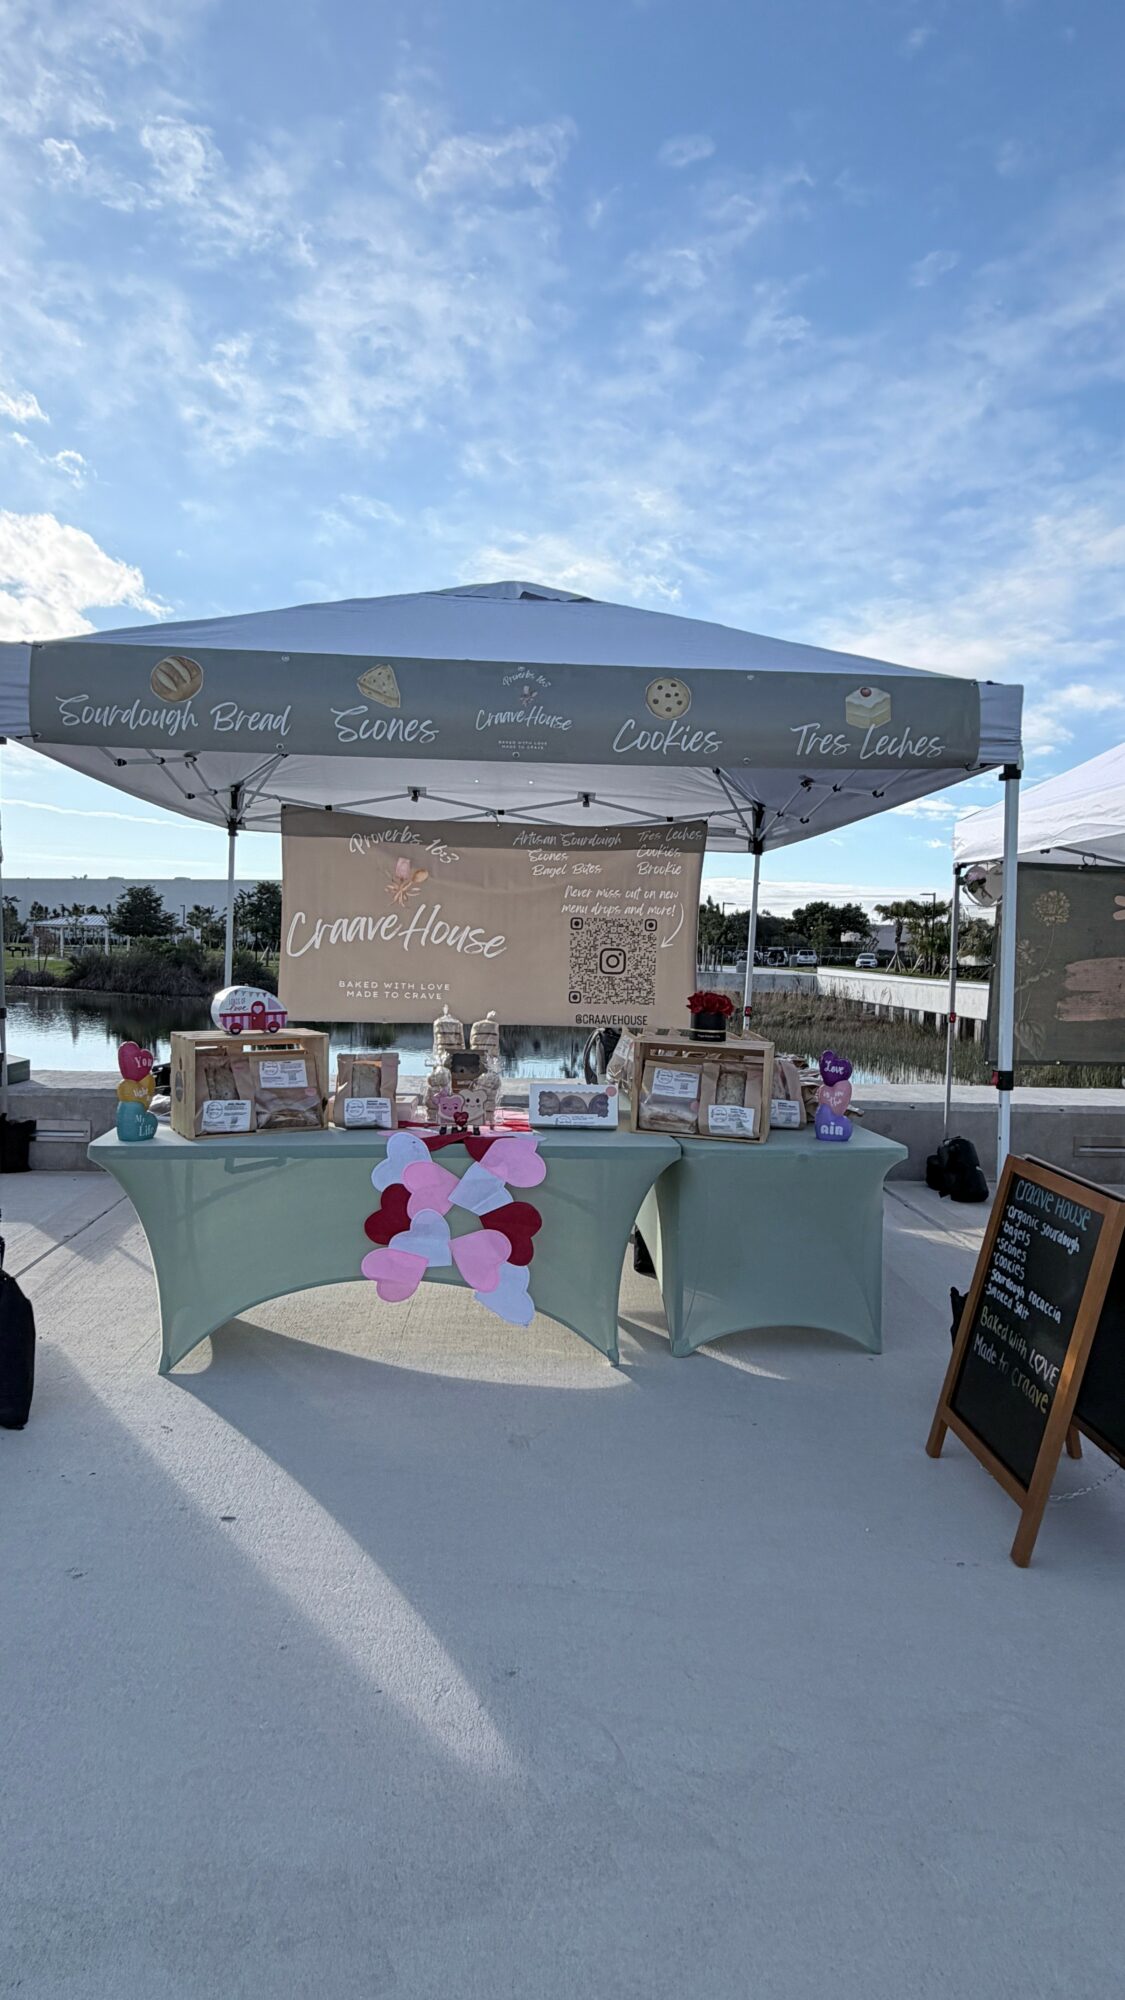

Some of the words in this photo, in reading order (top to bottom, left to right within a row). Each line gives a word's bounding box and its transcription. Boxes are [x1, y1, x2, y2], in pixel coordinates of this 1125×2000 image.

[55, 694, 199, 731] Sourdough
[210, 702, 292, 736] Bread
[331, 705, 439, 743] Scones
[613, 719, 722, 754] Cookies
[790, 722, 850, 757] Tres
[860, 724, 945, 760] Leches
[513, 830, 557, 846] Artisan
[560, 831, 623, 848] Sourdough
[637, 830, 660, 843] Tres
[665, 827, 704, 841] Leches
[349, 825, 421, 855] Proverbs
[425, 838, 460, 864] 16:3
[636, 843, 681, 858] Cookies
[527, 848, 570, 863] Scones
[531, 863, 567, 878] Bagel
[572, 862, 602, 875] Bites
[636, 861, 683, 876] Brookie
[564, 885, 593, 899] Never
[596, 887, 622, 899] miss
[625, 886, 642, 900] out
[644, 890, 657, 900] on
[659, 890, 679, 899] new
[561, 904, 588, 915] menu
[590, 902, 621, 917] drops
[624, 903, 645, 916] and
[647, 904, 676, 917] more!
[339, 980, 378, 989] BAKED
[383, 981, 416, 990] WITH
[420, 983, 451, 991] LOVE
[346, 990, 379, 999] MADE
[384, 991, 399, 999] TO
[404, 992, 443, 1000] CRAVE
[575, 1013, 649, 1026] @CRAAVEHOUSE
[823, 1060, 845, 1076] Love
[1003, 1221, 1031, 1246] bagels
[980, 1305, 1009, 1342] Baked
[973, 1332, 997, 1365] Made
